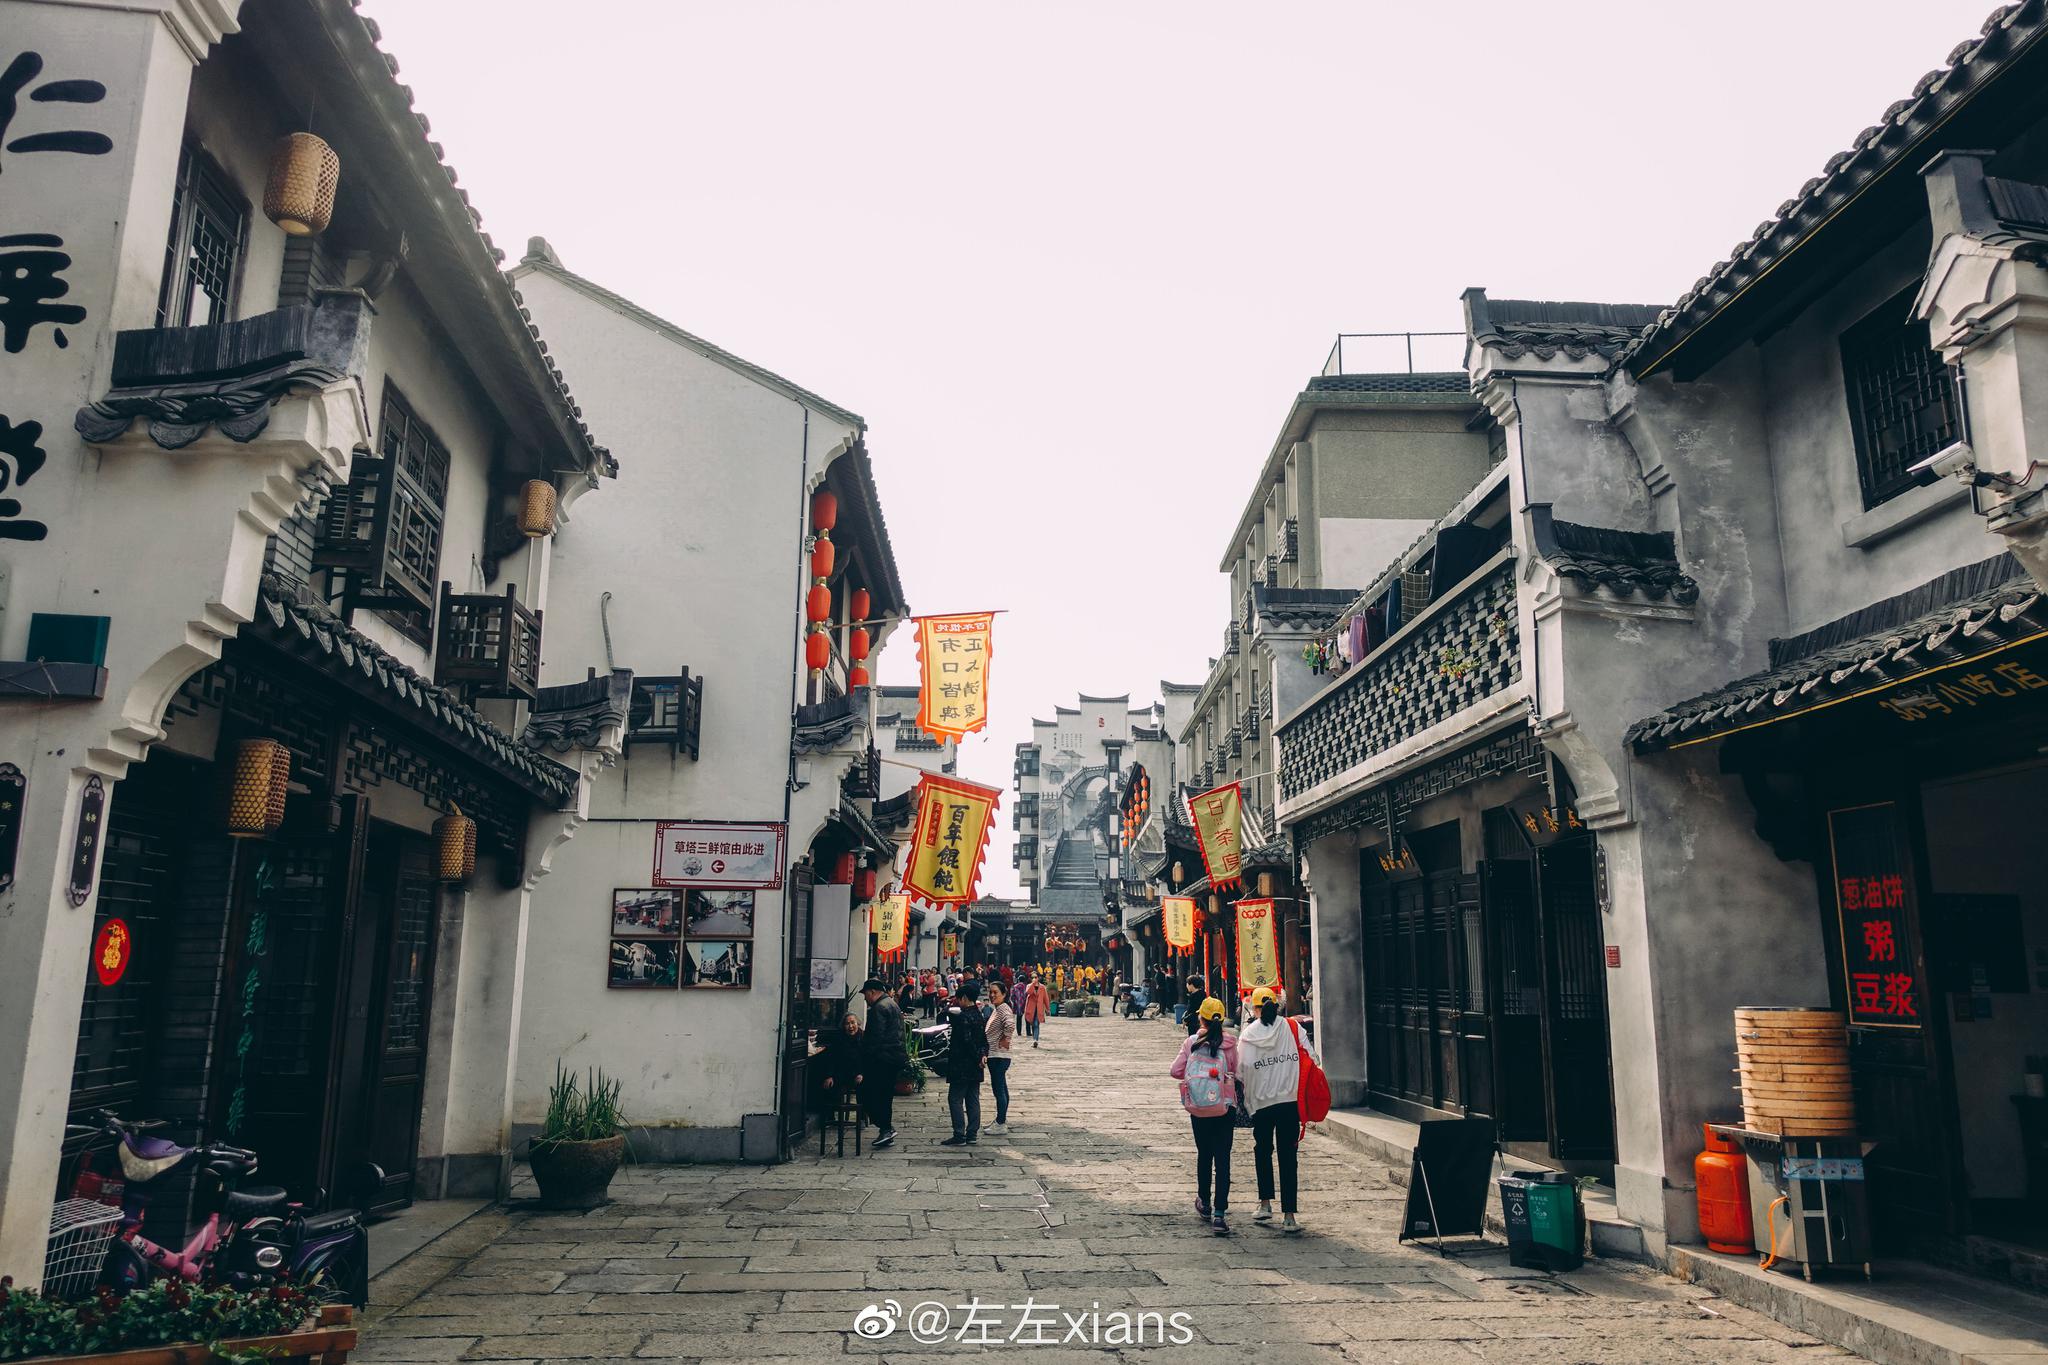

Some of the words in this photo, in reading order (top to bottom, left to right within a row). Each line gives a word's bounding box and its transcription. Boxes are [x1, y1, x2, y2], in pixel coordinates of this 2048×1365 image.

[673, 840, 765, 856] 草塔三鲜馆由此进
[1841, 874, 1904, 910] 葱油饼
[1862, 920, 1895, 961] 粥
[1853, 972, 1917, 1016] 豆浆
[1254, 1052, 1299, 1070] BALENCAG
